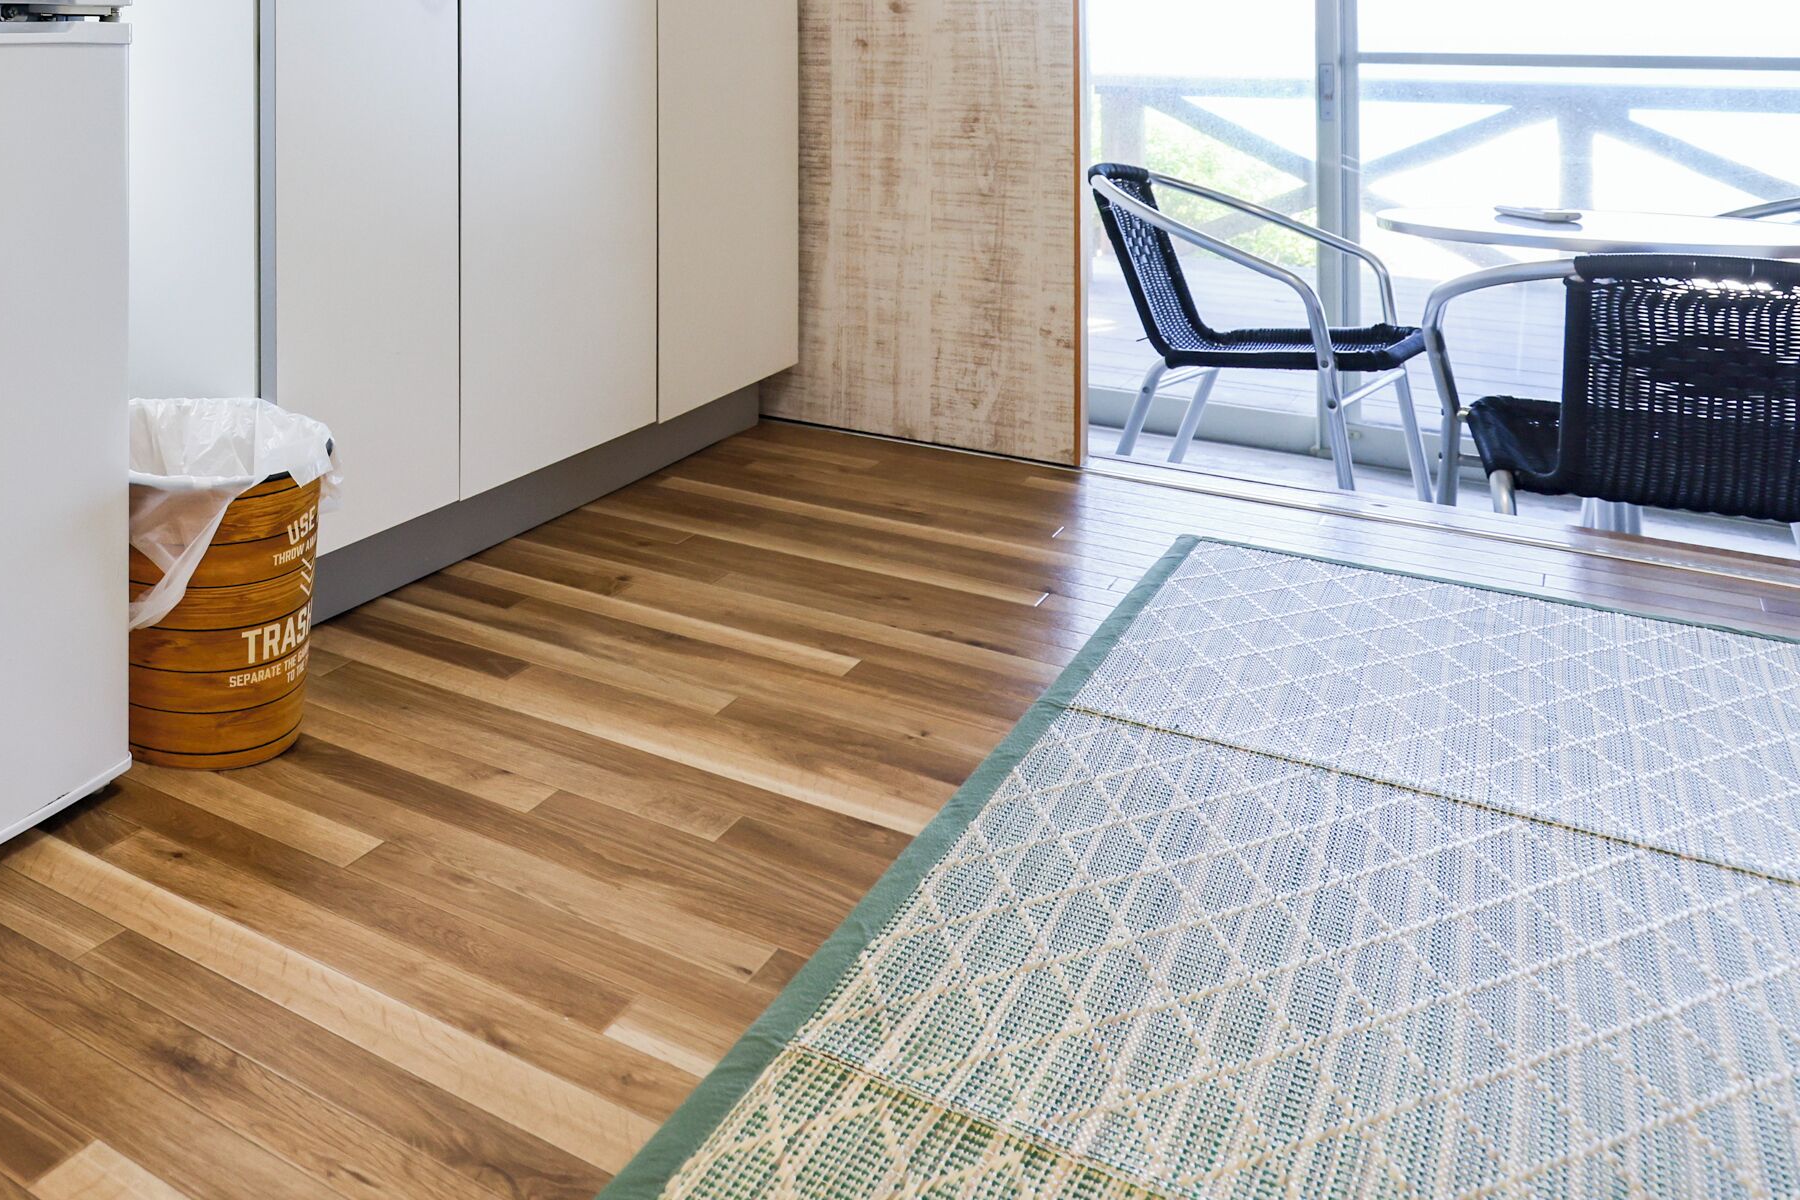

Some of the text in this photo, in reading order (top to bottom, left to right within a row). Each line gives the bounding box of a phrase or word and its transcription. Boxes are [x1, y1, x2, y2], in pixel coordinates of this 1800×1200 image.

[286, 505, 317, 546] USE
[272, 543, 305, 567] THROW
[241, 597, 313, 665] TRASH
[228, 663, 283, 688] SEPARATE
[283, 654, 297, 673] THE
[286, 669, 296, 684] TO
